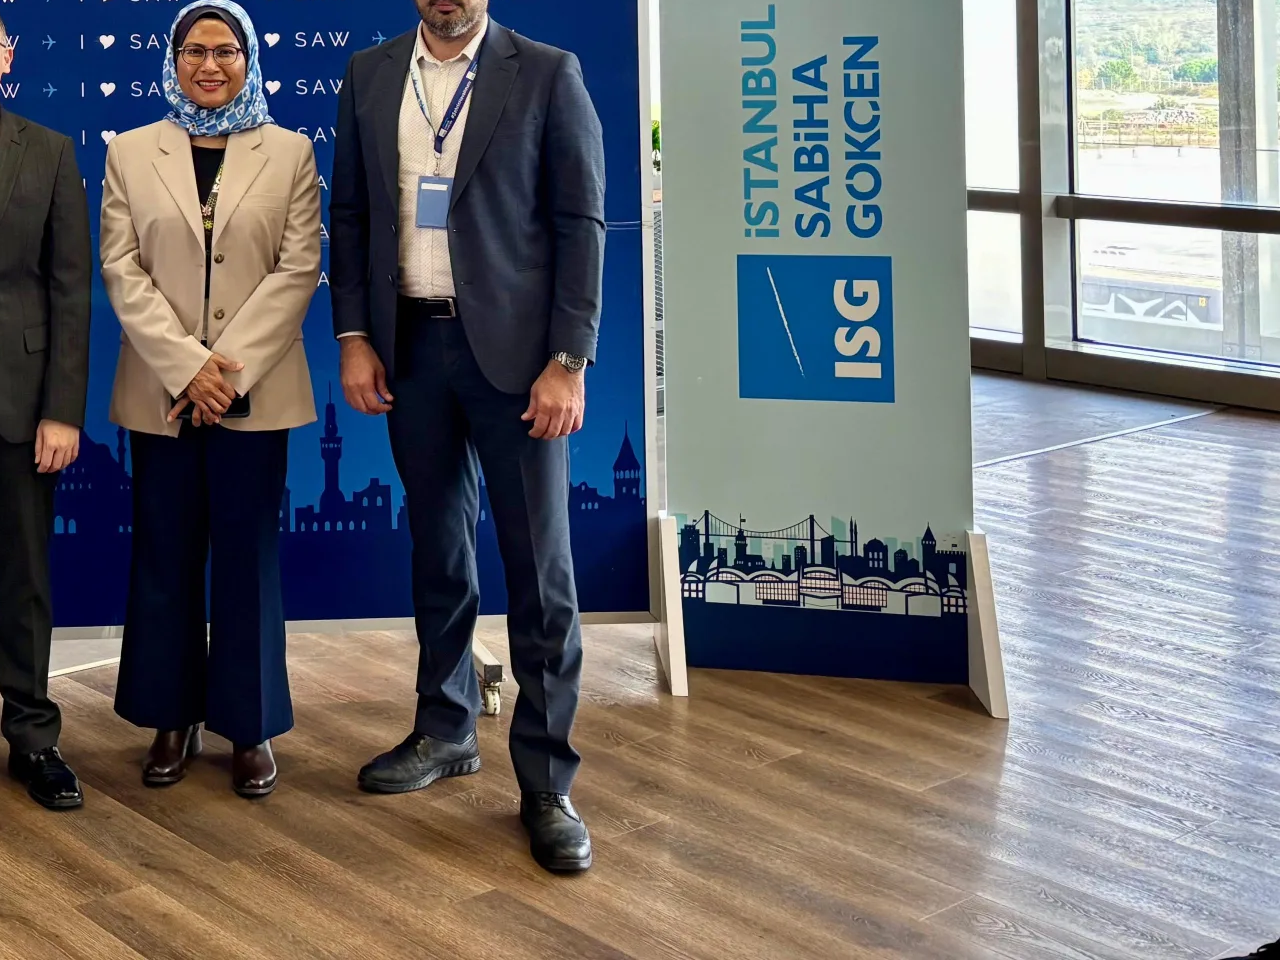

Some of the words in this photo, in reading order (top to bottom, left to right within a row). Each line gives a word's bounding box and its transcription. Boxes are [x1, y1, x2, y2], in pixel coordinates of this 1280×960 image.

[295, 31, 350, 48] SAW
[131, 81, 161, 97] SA
[833, 279, 882, 379] ISG
